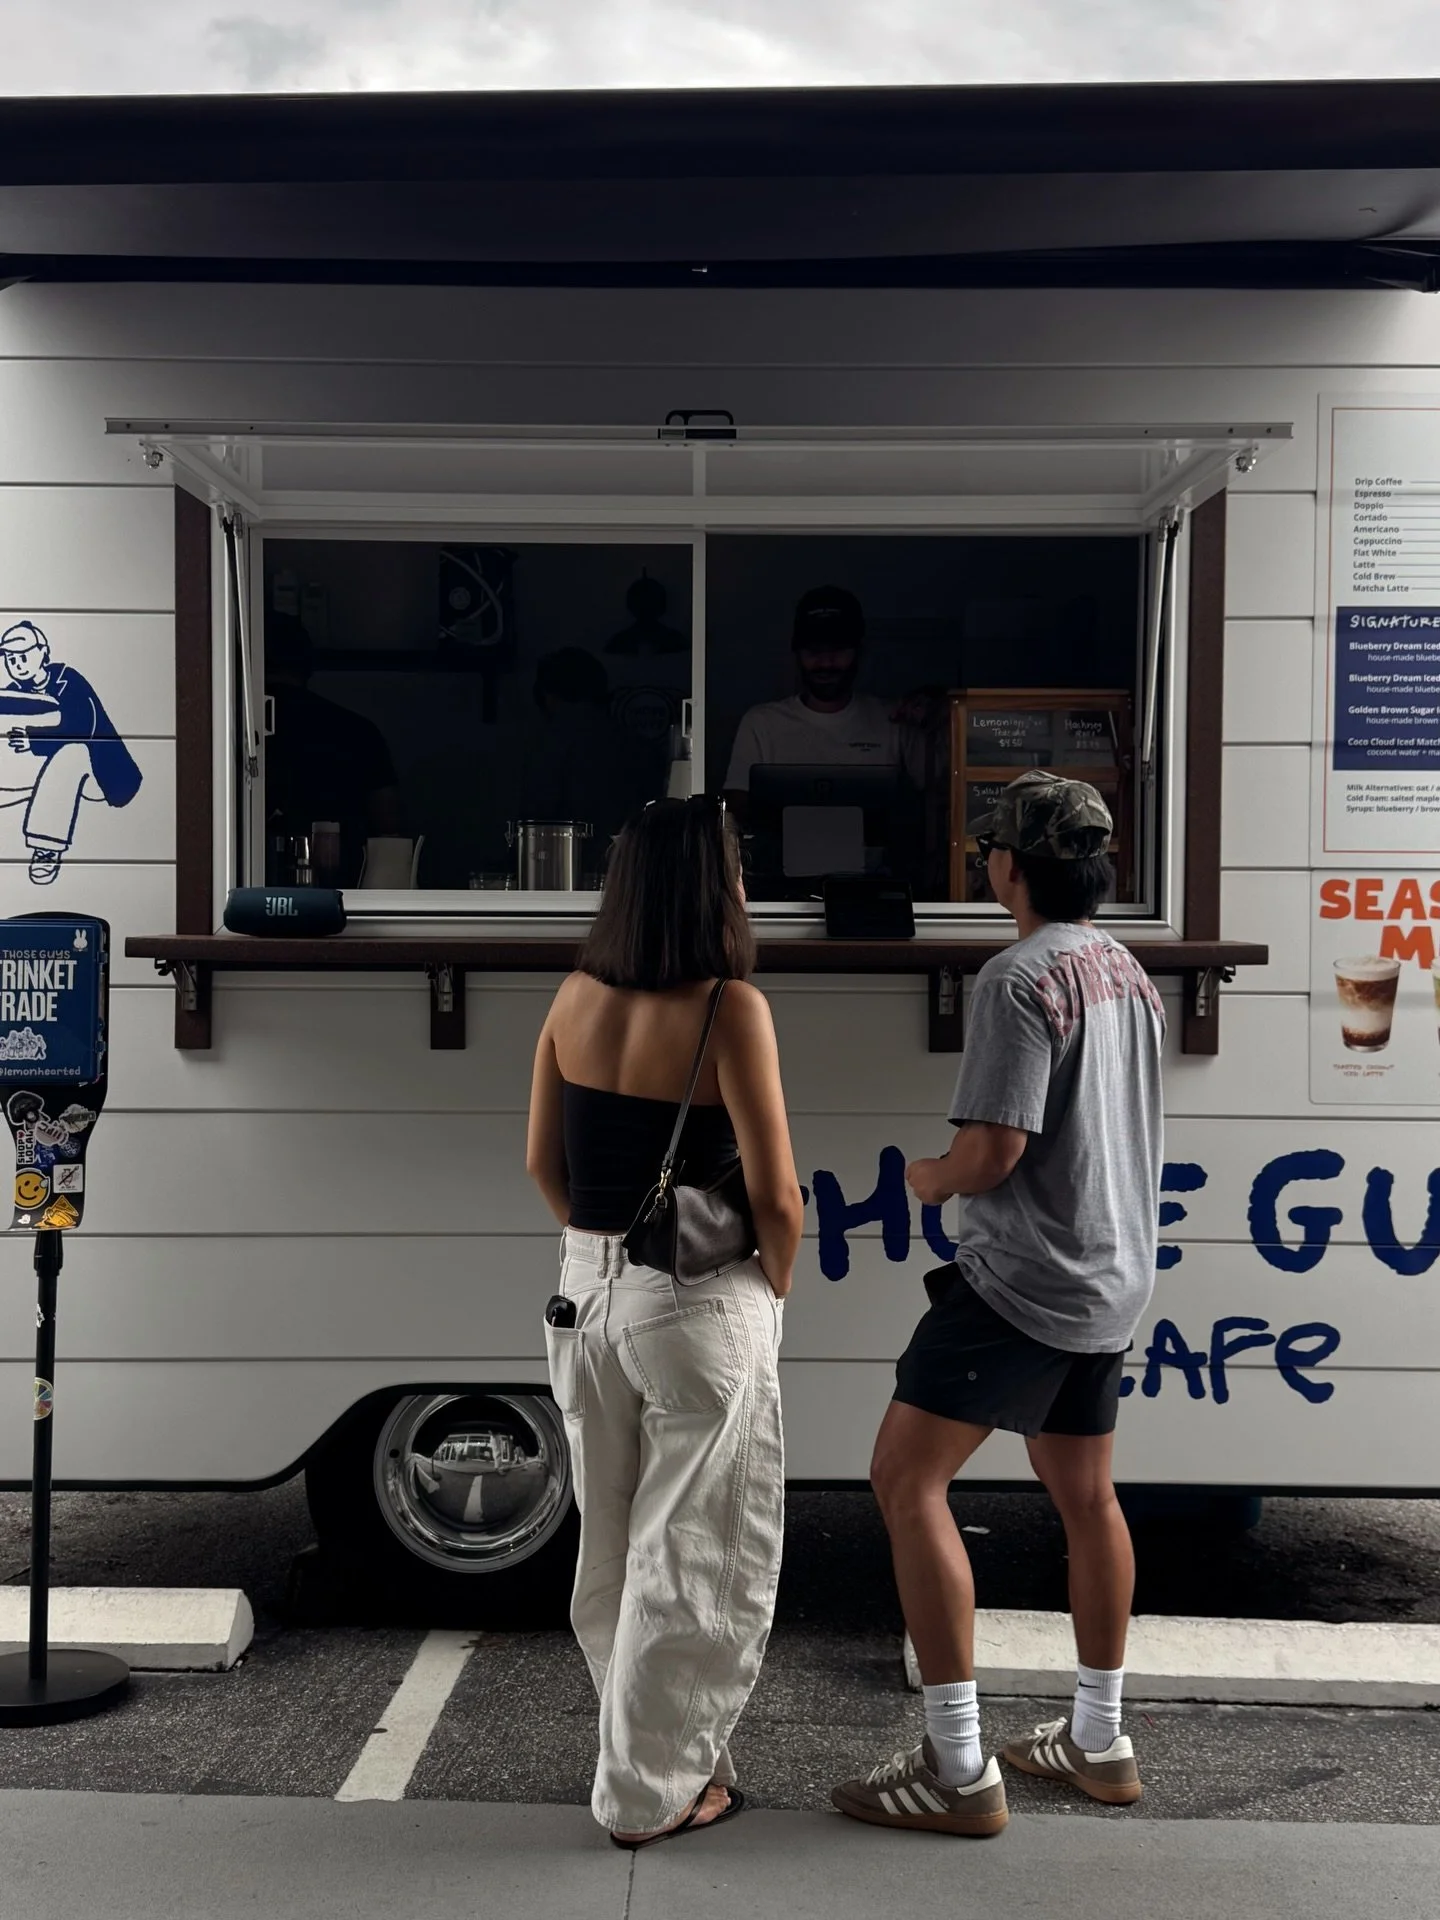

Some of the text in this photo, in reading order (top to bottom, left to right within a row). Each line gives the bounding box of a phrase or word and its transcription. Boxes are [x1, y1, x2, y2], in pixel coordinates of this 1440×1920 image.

[1355, 478, 1373, 487] Drip
[1355, 491, 1391, 499] Espresso
[1354, 502, 1383, 511] Doppio
[1353, 537, 1402, 546] Cappuccino
[1353, 549, 1396, 557] Flat White
[1353, 584, 1409, 592] Matcha Latte
[1349, 614, 1440, 628] SIGNATURE
[1349, 642, 1391, 652] Blueberry
[1393, 642, 1422, 650] Dream
[1349, 674, 1391, 684] Blueberry
[1393, 674, 1421, 682] Dream
[1366, 685, 1413, 693] house-made
[1348, 706, 1379, 714] Golden
[1380, 706, 1408, 714] Brown
[1410, 706, 1434, 716] Sugar
[1348, 738, 1368, 746] Coco
[1370, 738, 1395, 746] Cloud
[1397, 738, 1414, 746] Iced
[1416, 795, 1439, 803] maple
[1346, 805, 1373, 813] Syrups:
[1376, 805, 1413, 814] blueberry
[265, 897, 298, 916] JBL
[3, 950, 71, 959] THOSE GUYS
[0, 991, 58, 1022] RADE
[1118, 1316, 1340, 1404] AFe
